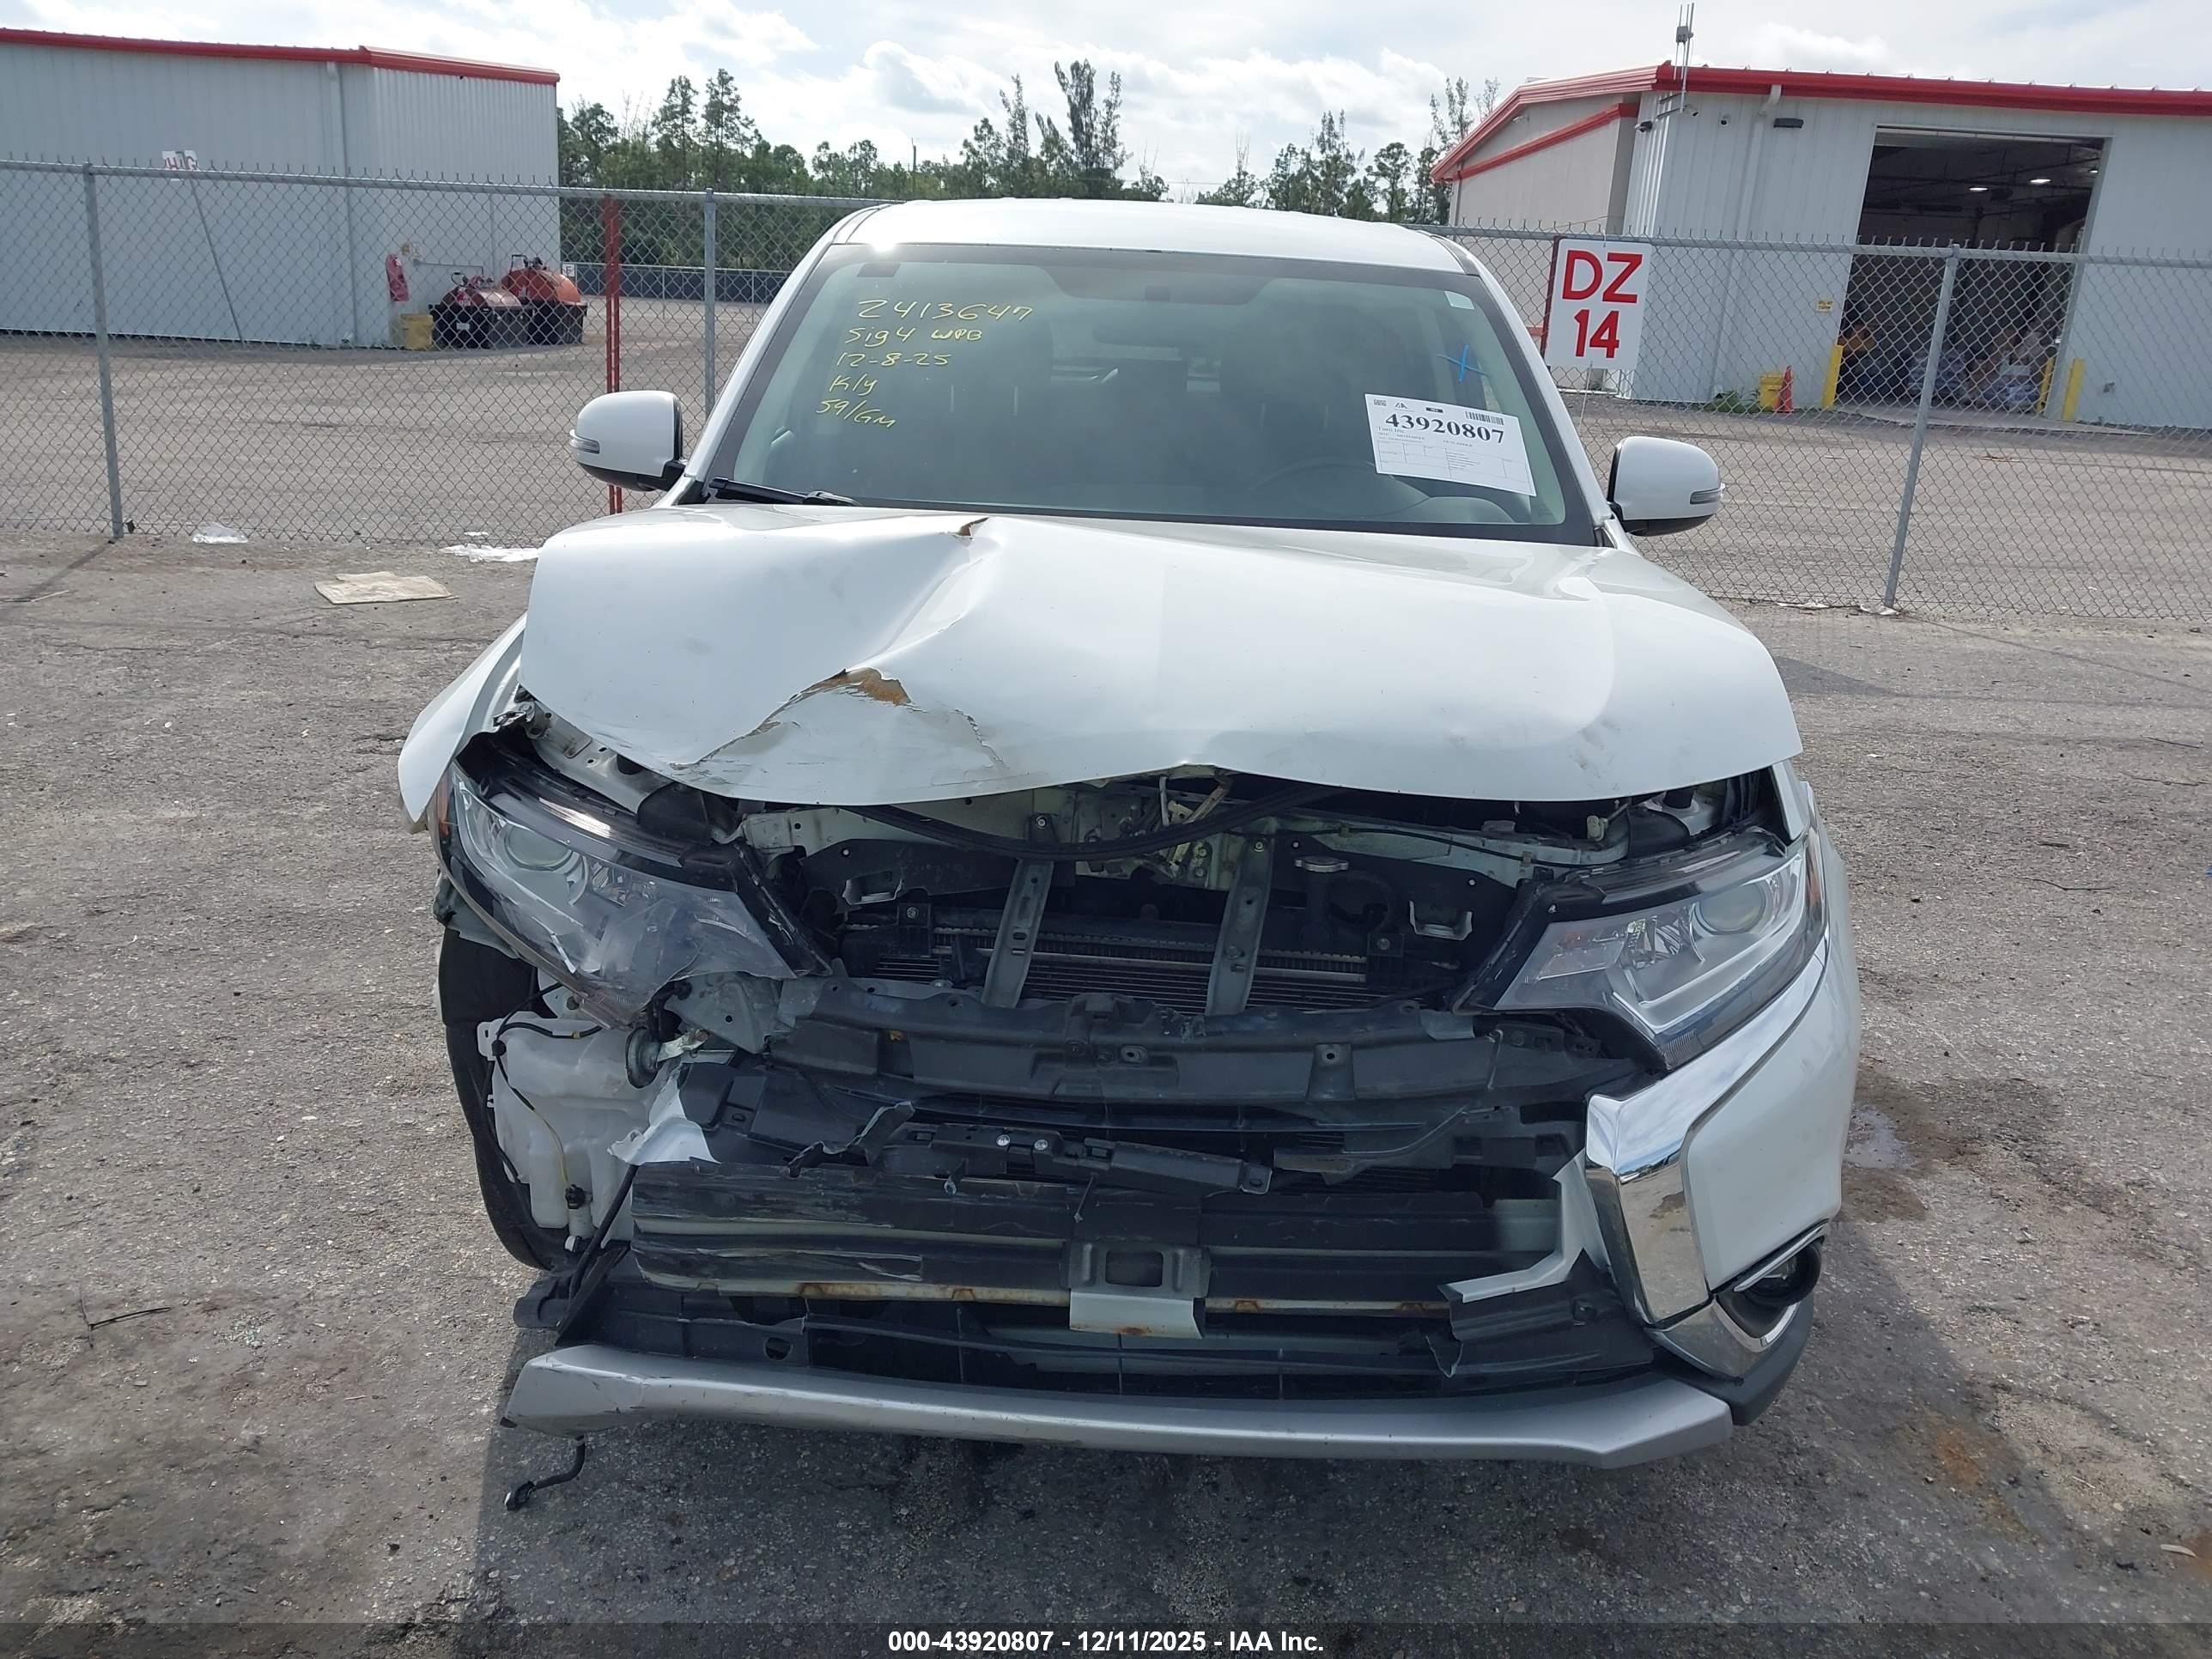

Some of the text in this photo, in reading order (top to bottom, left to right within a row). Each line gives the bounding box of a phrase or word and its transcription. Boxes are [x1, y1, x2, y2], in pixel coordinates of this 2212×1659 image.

[1562, 250, 1643, 304] DZ
[1574, 309, 1620, 358] 14
[836, 352, 952, 368] 12-8-25
[1385, 413, 1504, 444] 43920807
